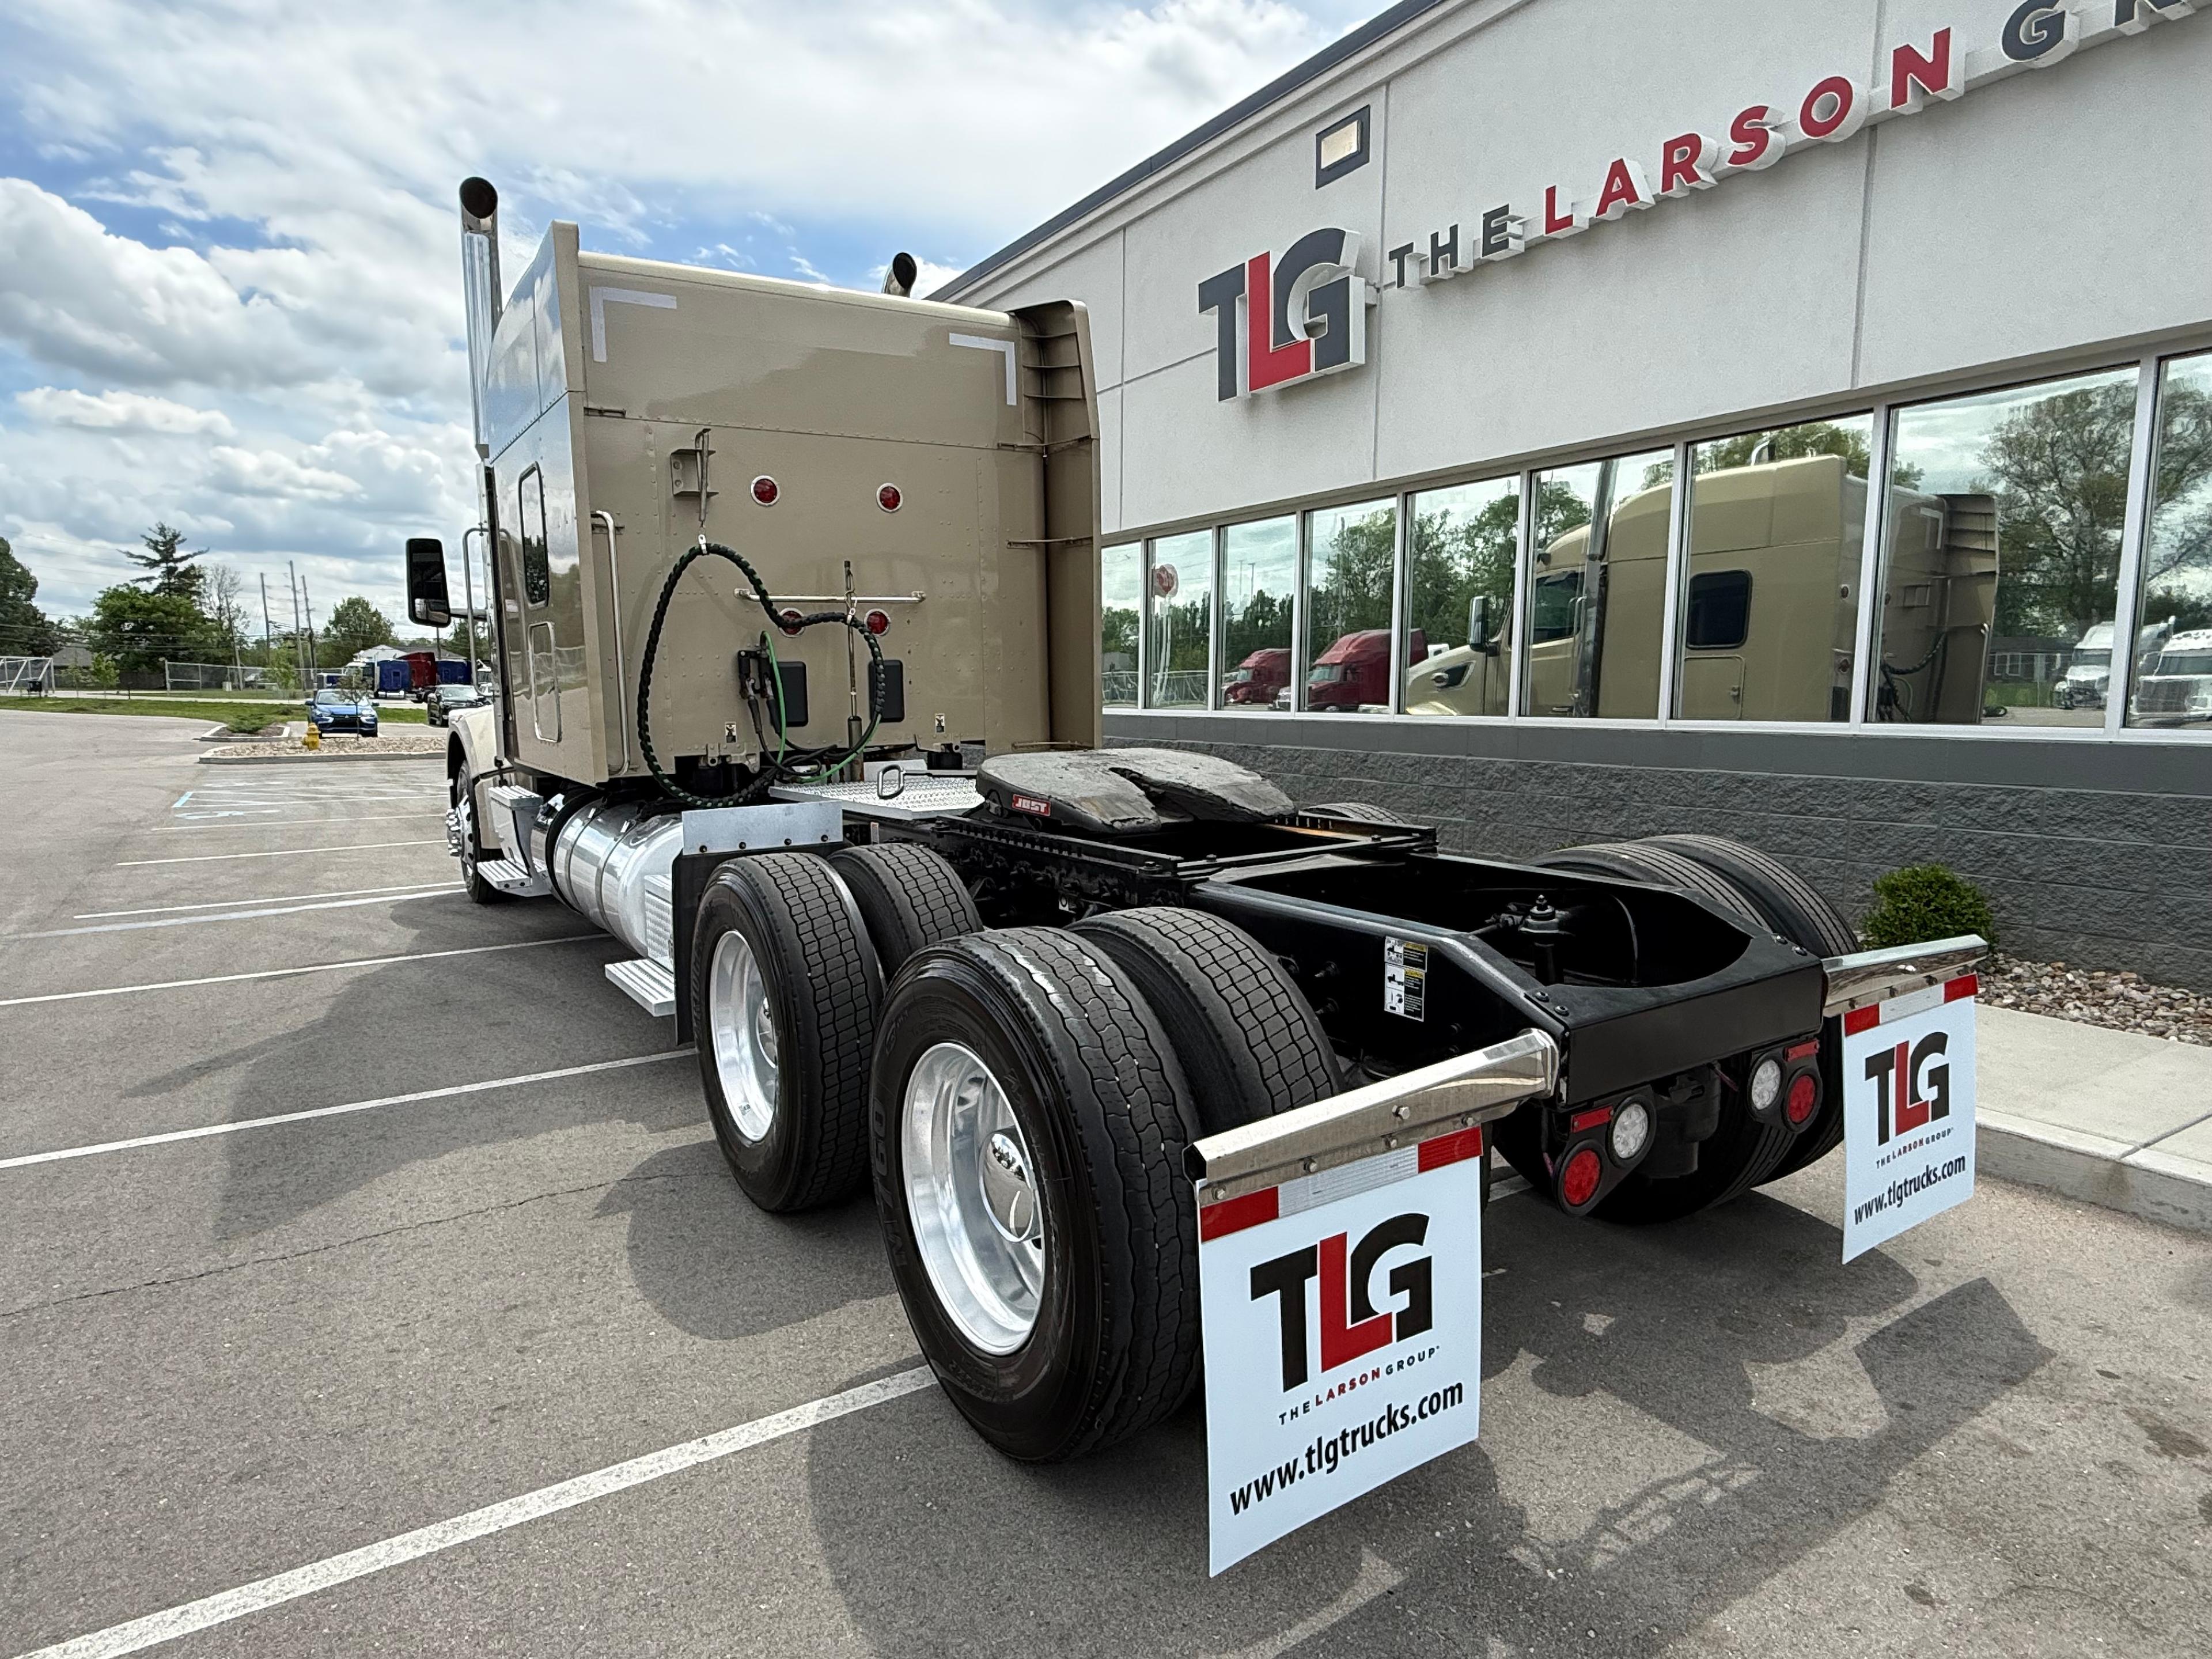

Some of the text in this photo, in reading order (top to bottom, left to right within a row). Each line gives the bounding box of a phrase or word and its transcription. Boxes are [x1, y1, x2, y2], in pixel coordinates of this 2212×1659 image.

[1388, 203, 1513, 290] THE
[1545, 26, 1955, 236] LARSON
[1198, 228, 1358, 403] TLG
[1015, 798, 1047, 813] JOST
[1865, 1031, 1950, 1146] TLG
[1854, 1156, 1965, 1225] www.tlgtrucks.com
[1876, 1127, 1952, 1169] THE LARSON GROUP
[1250, 1213, 1433, 1392] TLG
[1278, 1346, 1437, 1425] THE LARSON GROUP
[1229, 1381, 1463, 1515] www.tlgtrucks.com
